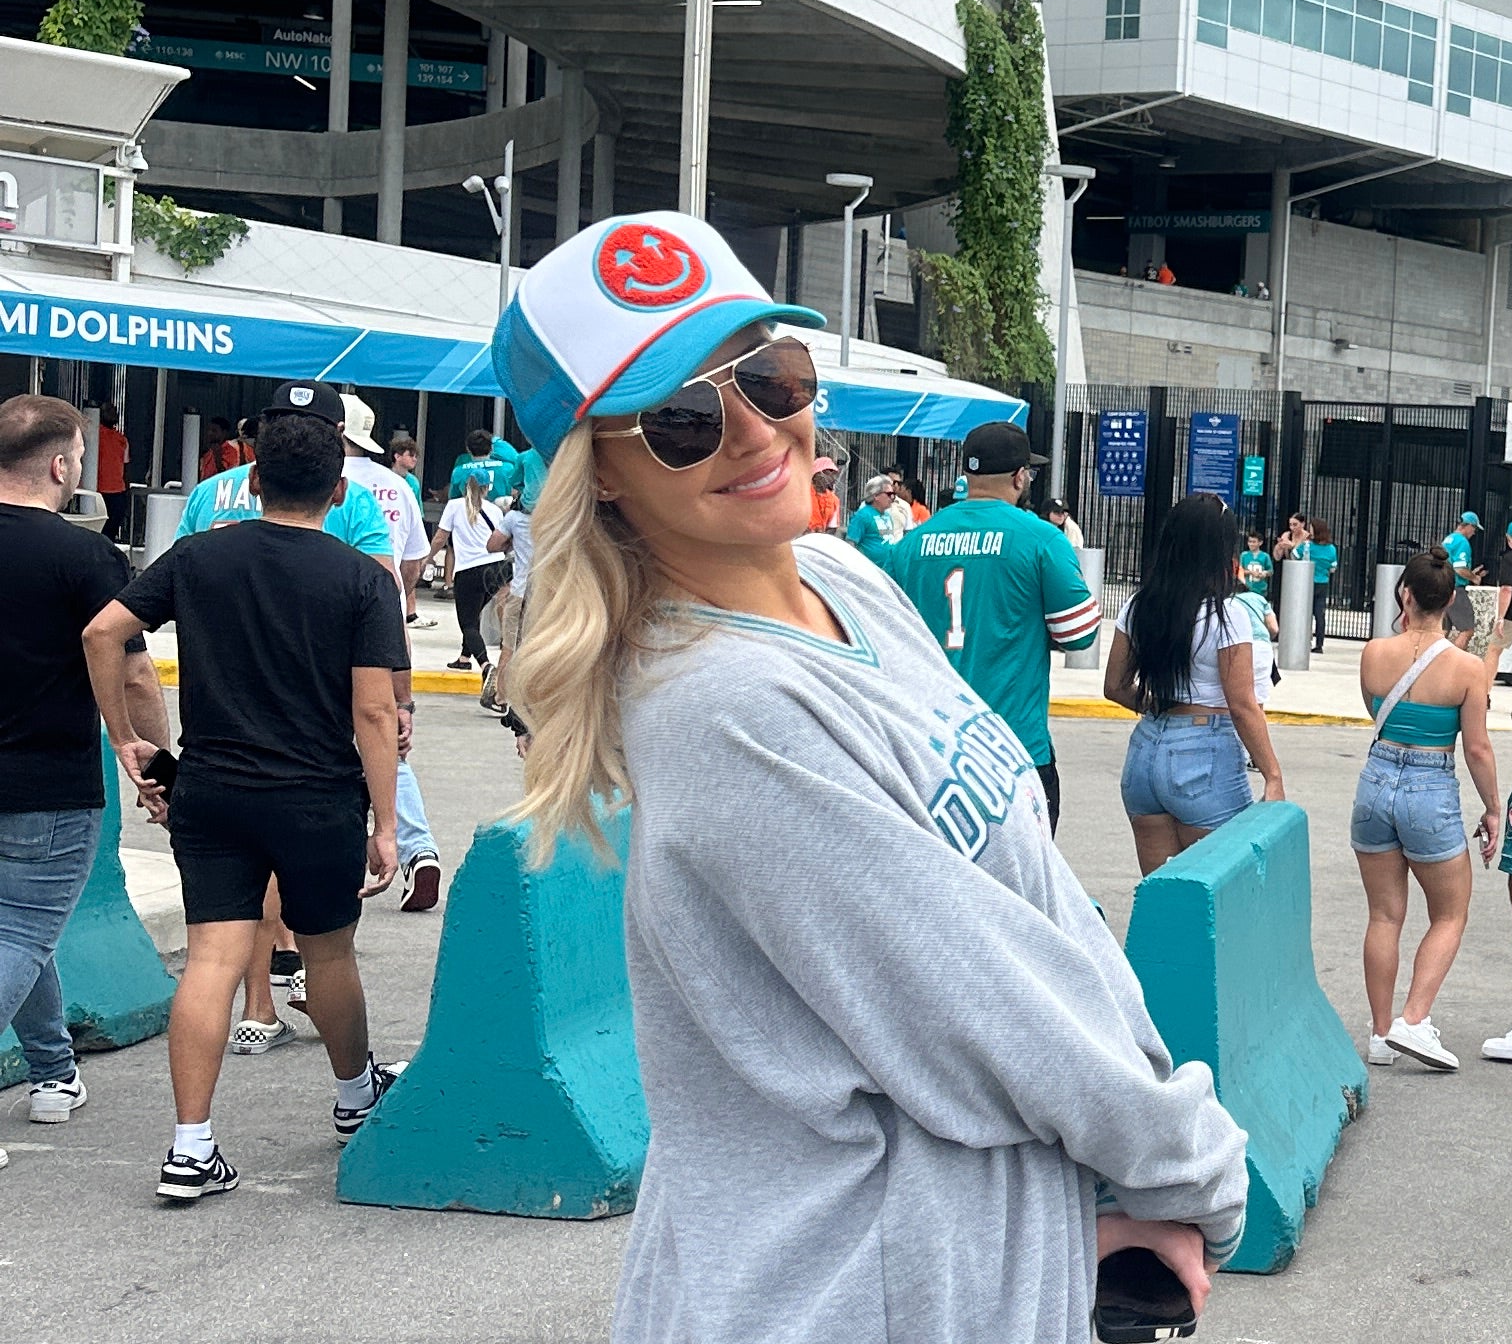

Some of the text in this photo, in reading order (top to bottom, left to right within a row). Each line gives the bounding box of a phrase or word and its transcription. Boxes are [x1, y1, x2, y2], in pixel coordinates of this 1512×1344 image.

[265, 50, 303, 70] NW
[310, 56, 333, 73] 10
[1128, 215, 1261, 229] FATBOY SMASHBURGERS
[49, 305, 234, 355] DOLPHINS
[213, 478, 263, 512] MA
[920, 532, 1004, 556] TAGOVAILOA
[945, 568, 966, 650] 1
